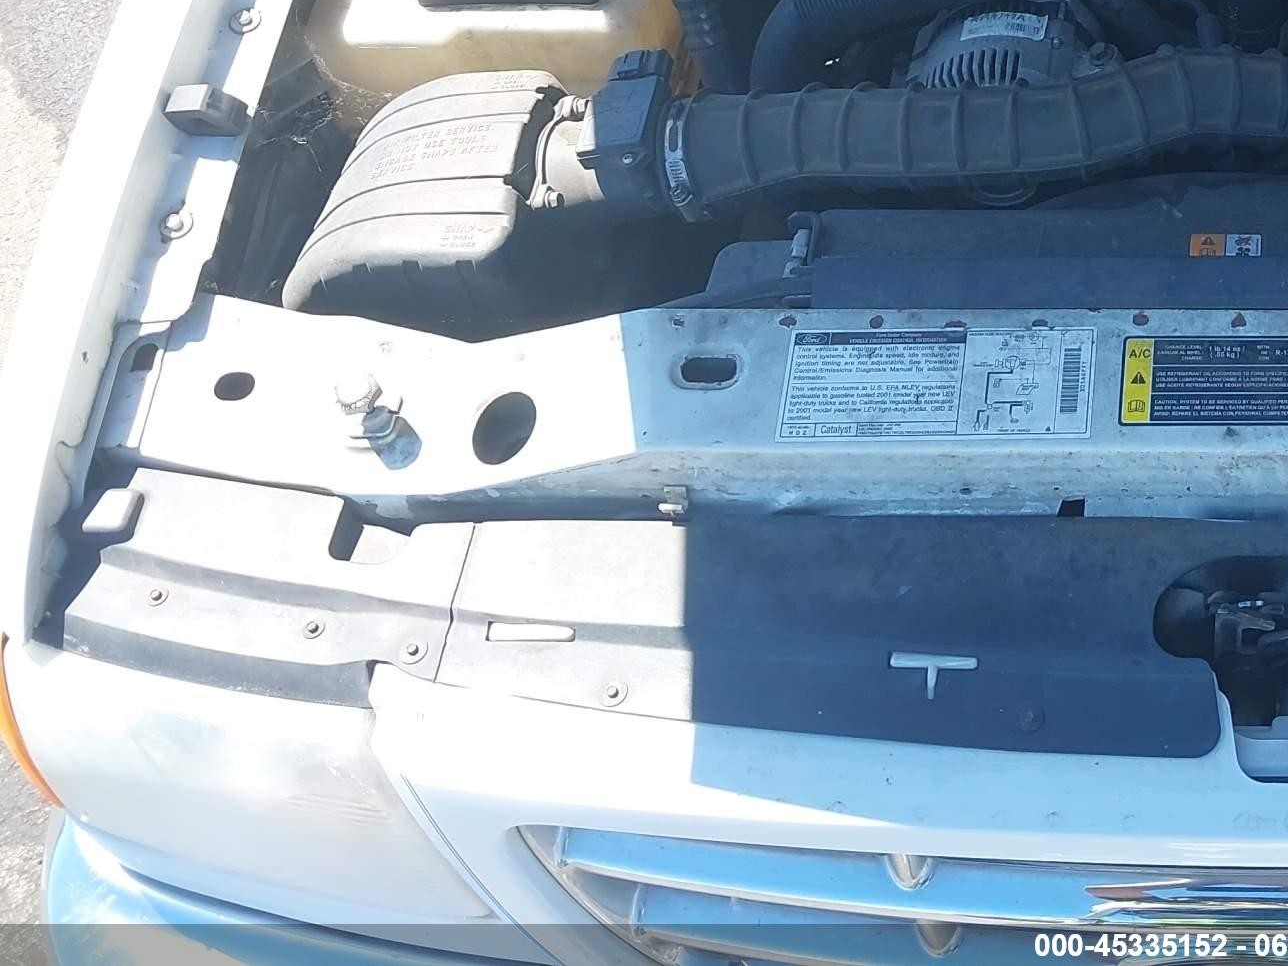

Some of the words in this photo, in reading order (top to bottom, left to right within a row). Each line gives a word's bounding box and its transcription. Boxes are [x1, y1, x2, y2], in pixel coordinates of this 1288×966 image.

[424, 138, 445, 150] USE
[450, 135, 488, 146] TOOLS
[1128, 348, 1152, 358] A/C
[820, 425, 852, 436] Catalyst
